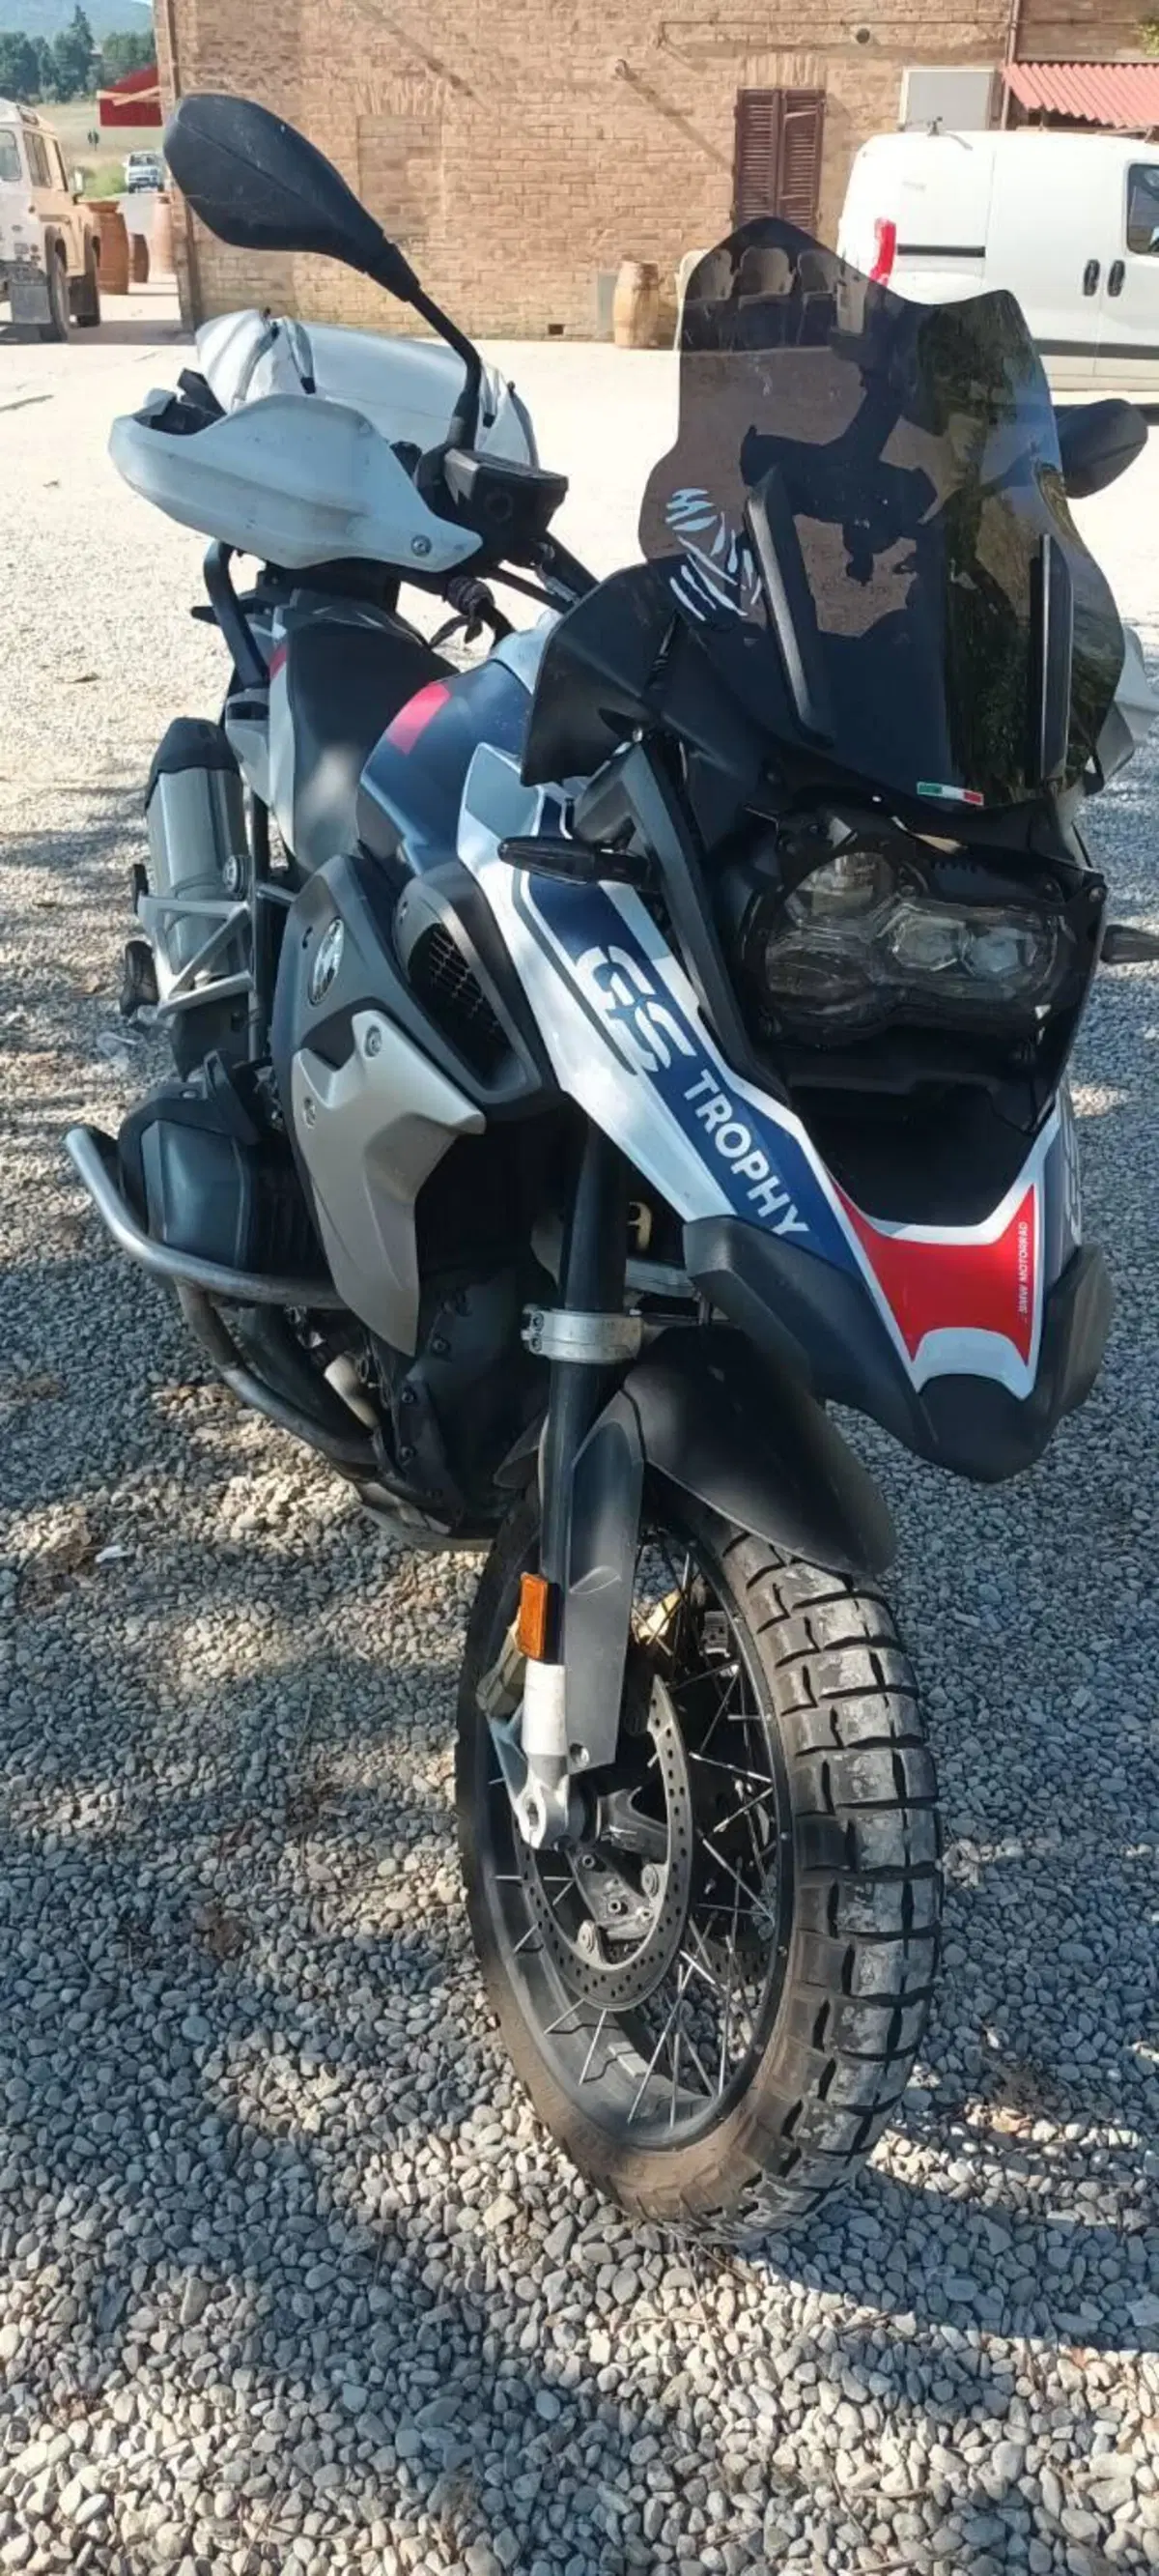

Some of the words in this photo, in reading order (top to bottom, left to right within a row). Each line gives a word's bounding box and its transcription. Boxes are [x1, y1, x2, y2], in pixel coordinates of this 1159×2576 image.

[576, 946, 697, 1073] GS
[683, 1069, 809, 1236] TROPHY
[1018, 1220, 1028, 1283] MOTORRAD
